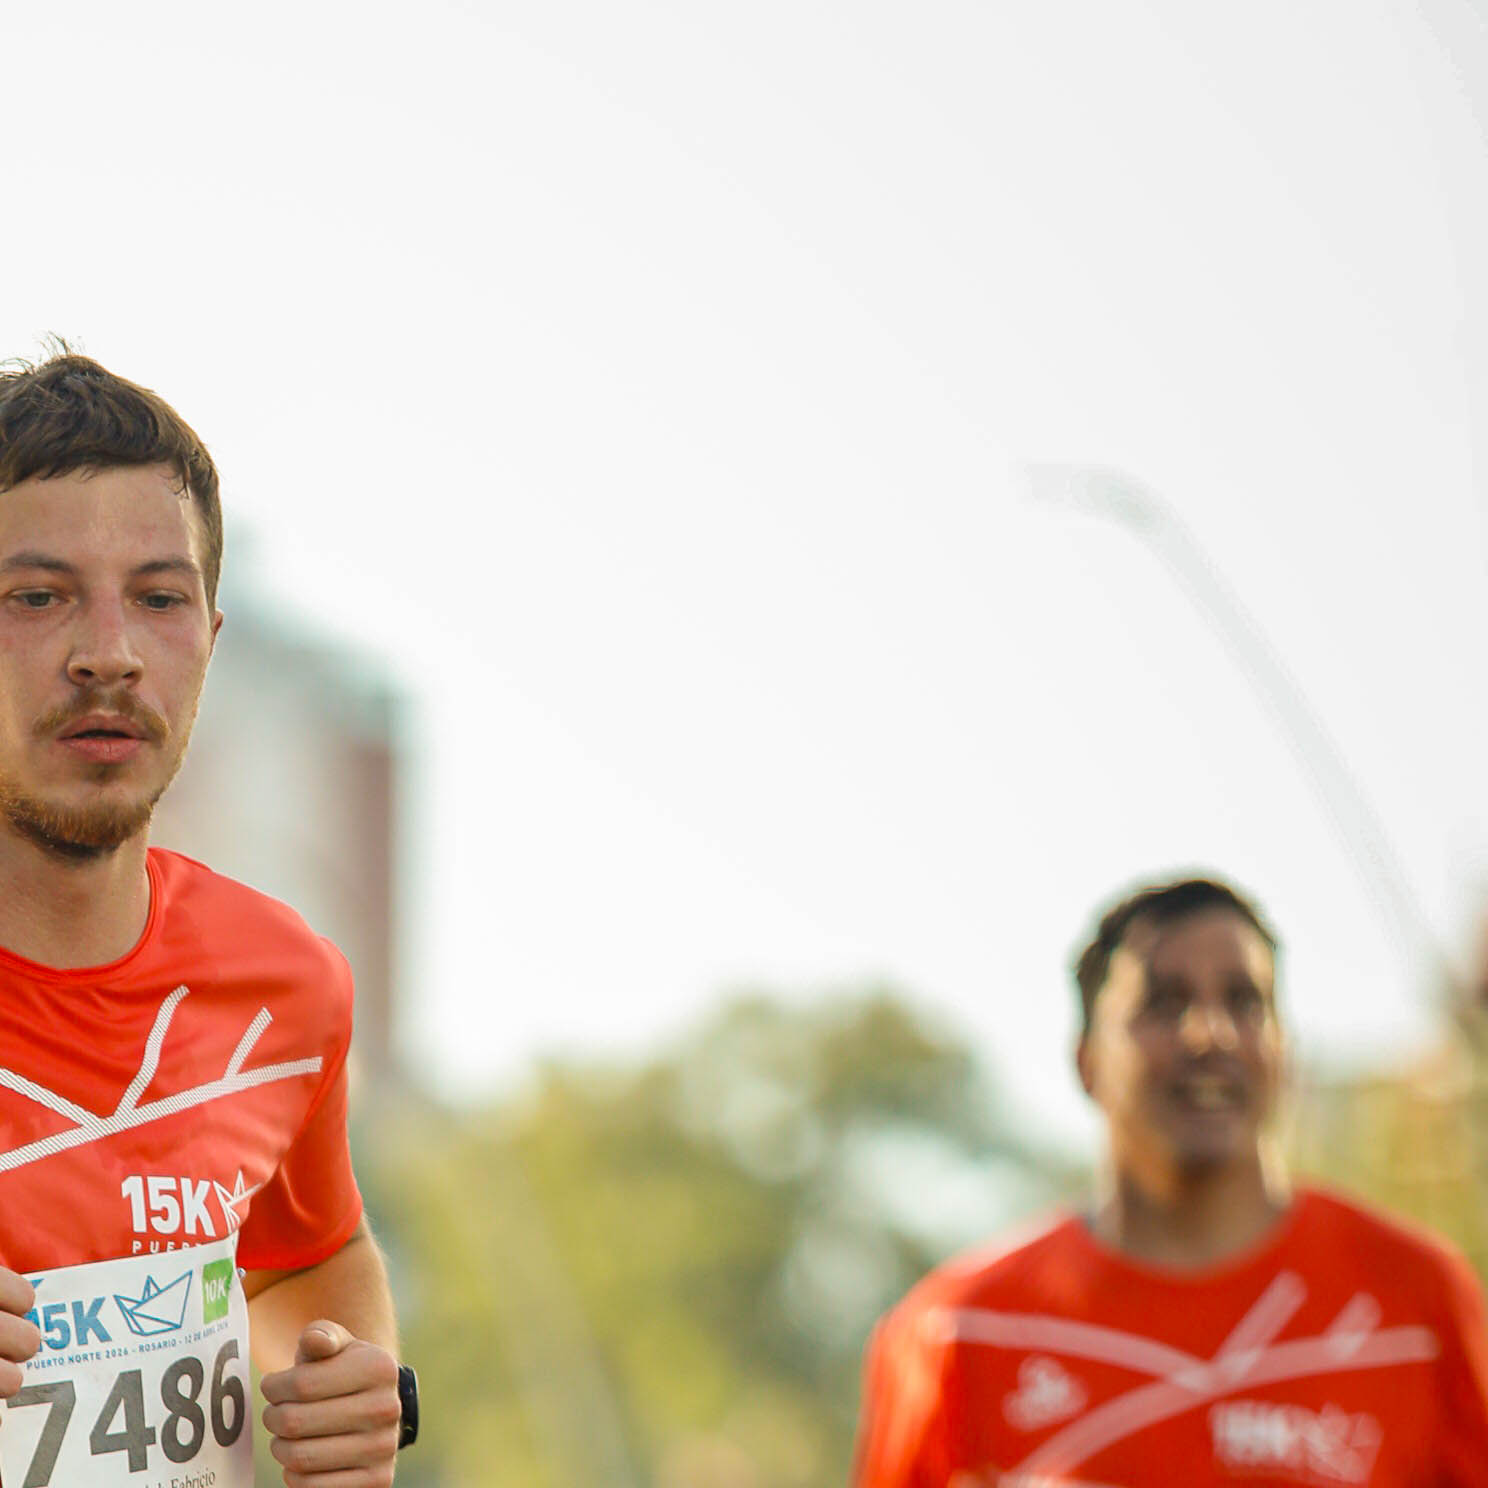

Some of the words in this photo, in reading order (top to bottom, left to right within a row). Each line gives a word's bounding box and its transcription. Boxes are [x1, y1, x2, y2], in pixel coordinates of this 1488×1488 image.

[120, 1174, 217, 1238] 15K
[204, 1275, 229, 1306] 10K
[25, 1356, 65, 1370] PUERTO
[68, 1351, 102, 1364] NORTE
[105, 1347, 129, 1359] 2026
[138, 1338, 177, 1353] ROSARIO
